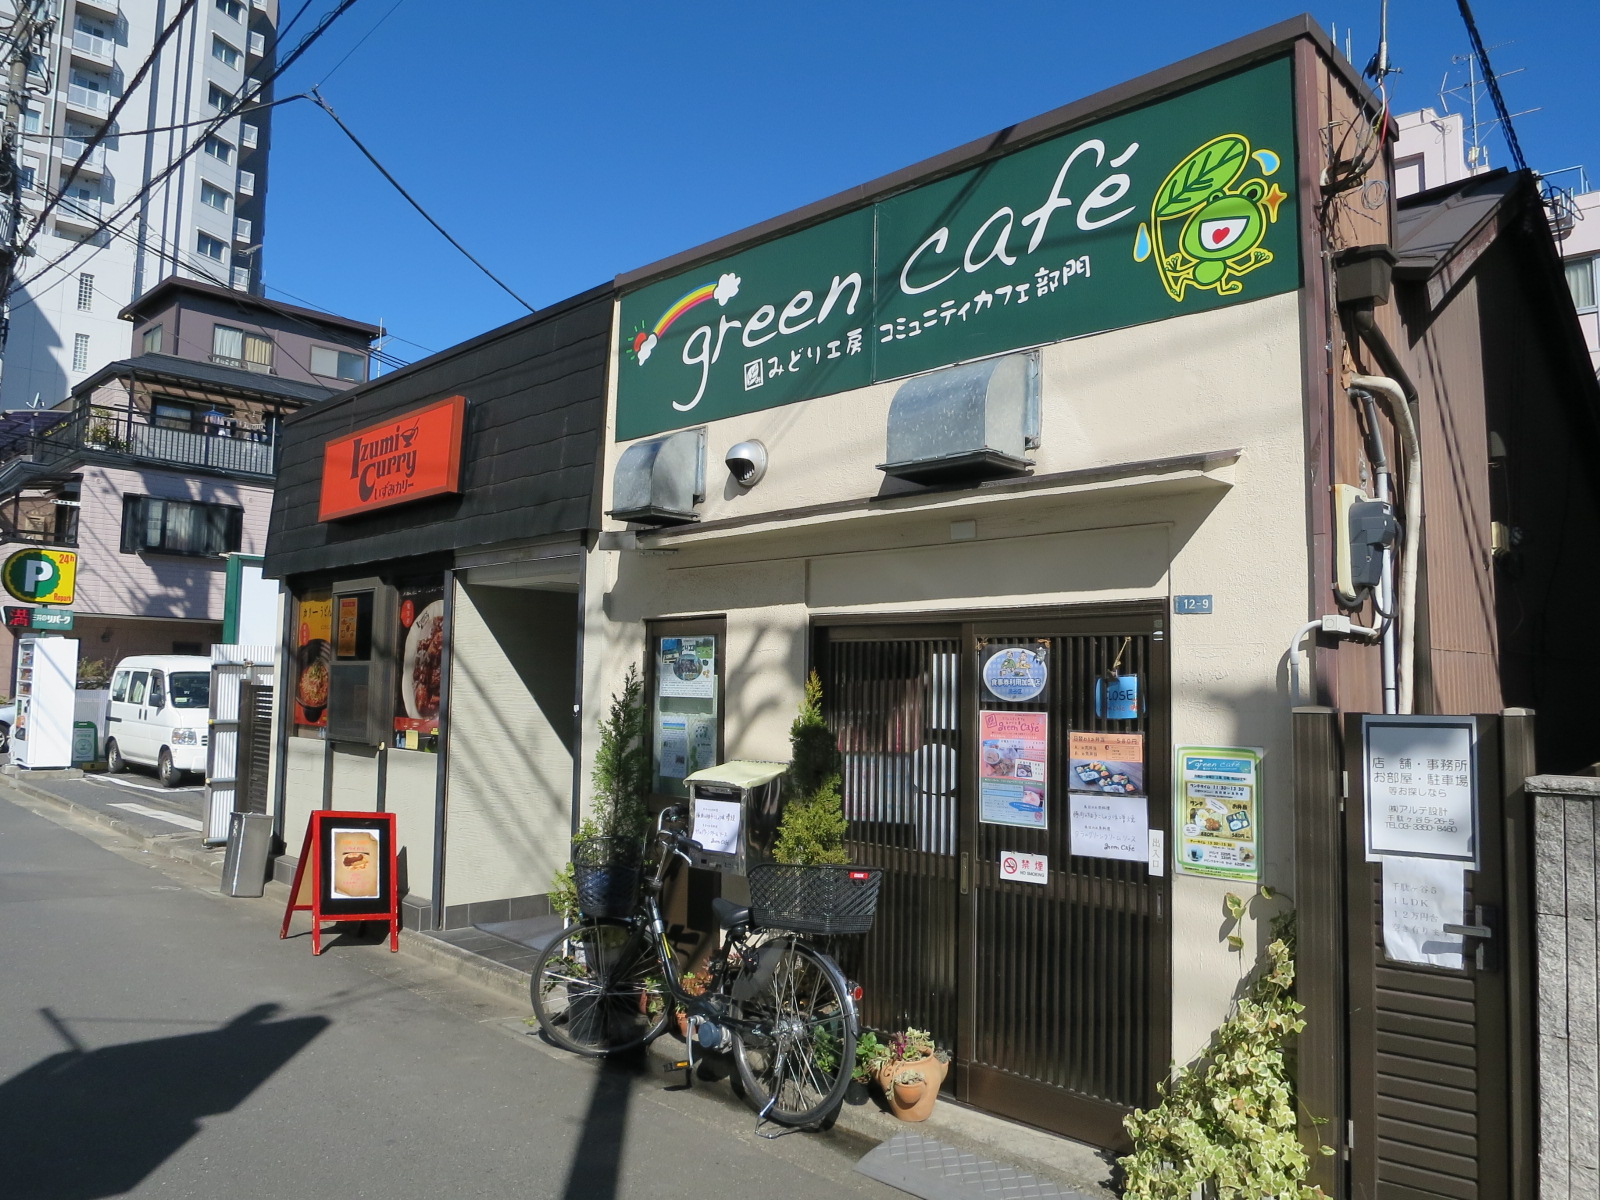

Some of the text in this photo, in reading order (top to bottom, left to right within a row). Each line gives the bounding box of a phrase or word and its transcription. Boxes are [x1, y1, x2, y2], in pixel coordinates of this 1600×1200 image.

[672, 139, 1140, 412] green café
[768, 255, 1091, 379] みどり工房 コミュニティカフェ部門
[350, 425, 400, 480] Izumi
[358, 450, 417, 502] Curry
[374, 479, 414, 500] いずみカリー
[24, 560, 53, 592] P
[1183, 599, 1209, 609] 12-9
[9, 608, 29, 627] 満
[1104, 689, 1134, 701] LOSE
[1373, 772, 1469, 787] お部屋・駐車場
[1388, 786, 1447, 798] 等お探しなら
[1152, 837, 1161, 869] 出入口
[1021, 859, 1044, 872] 禁煙
